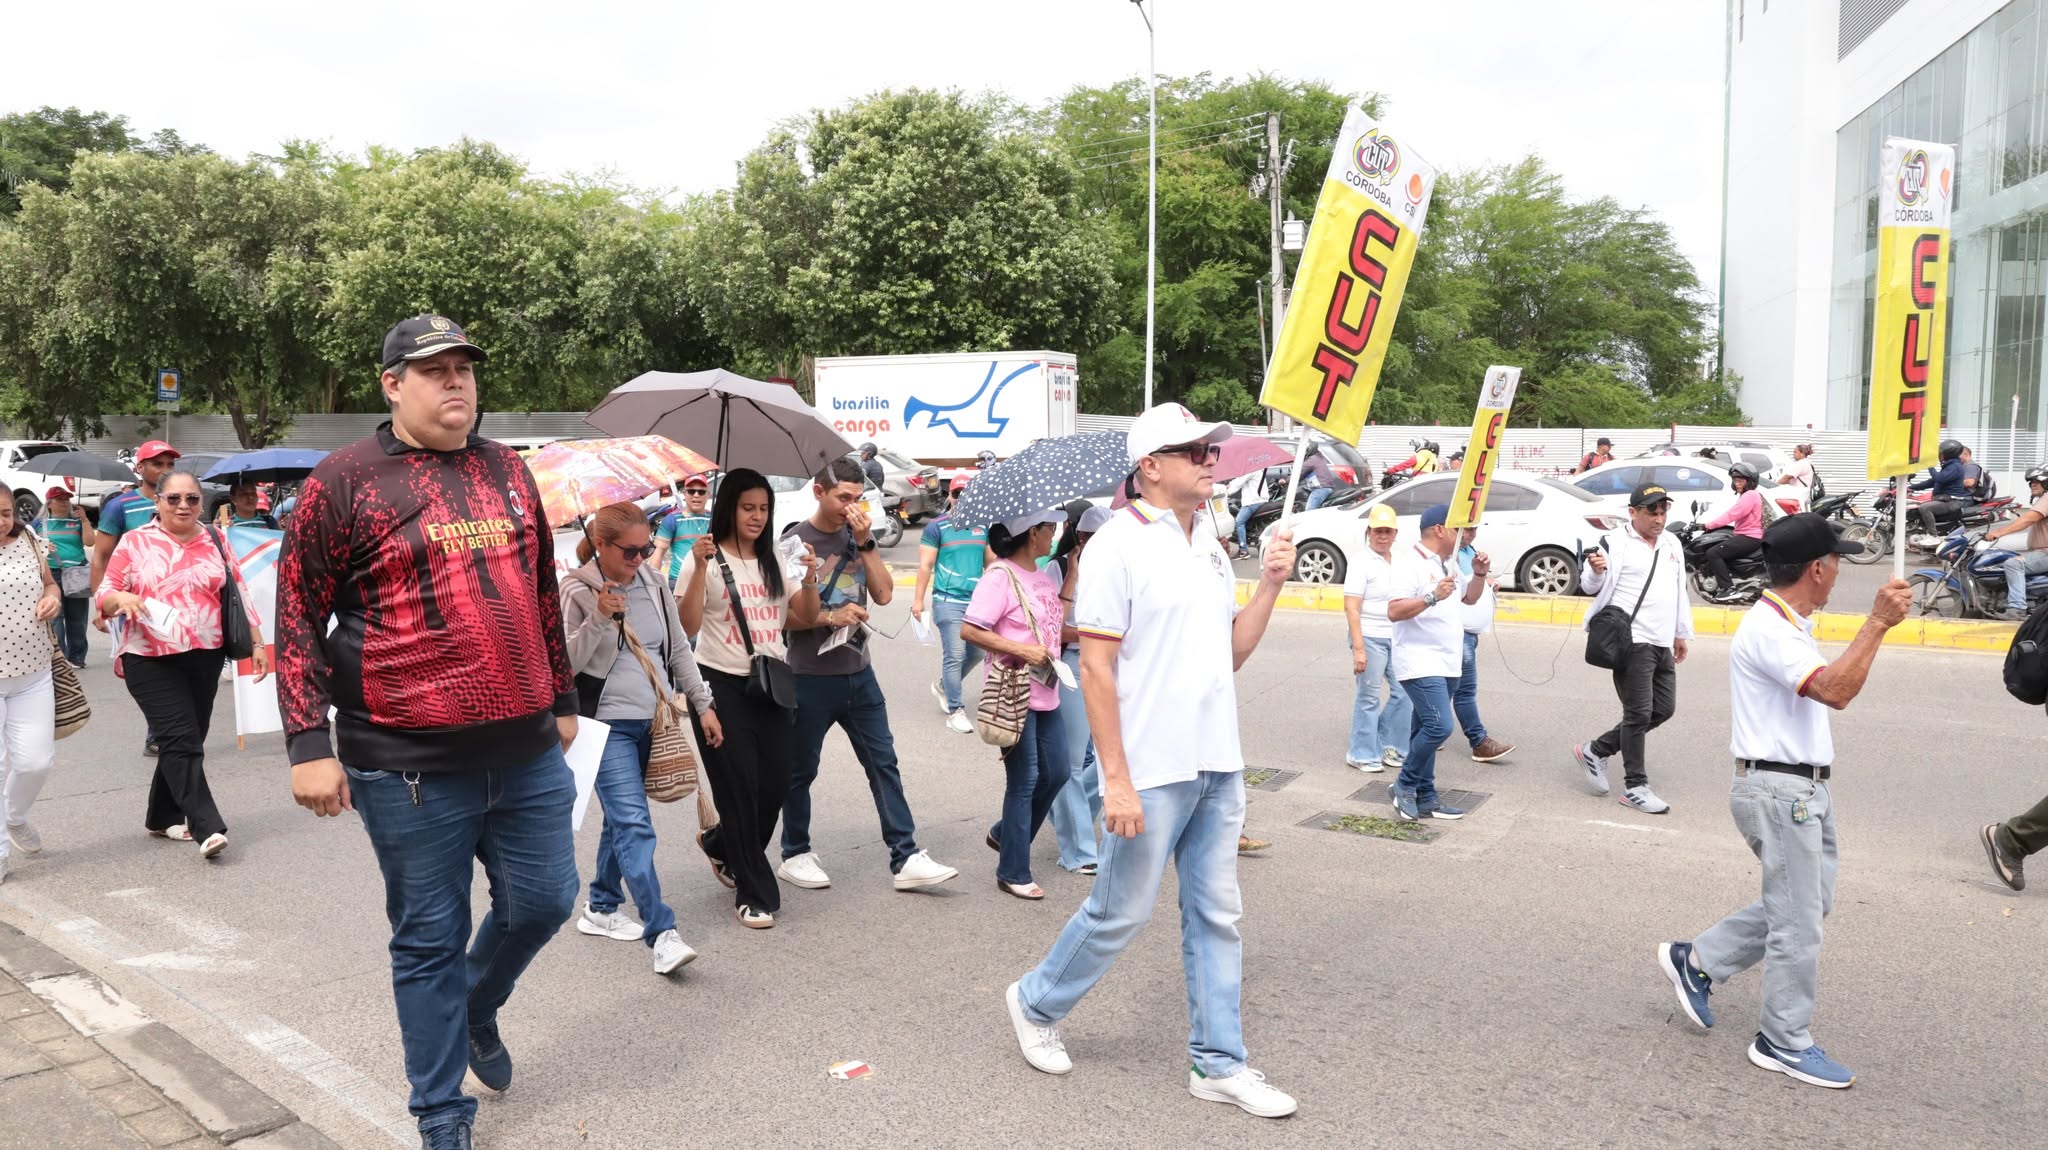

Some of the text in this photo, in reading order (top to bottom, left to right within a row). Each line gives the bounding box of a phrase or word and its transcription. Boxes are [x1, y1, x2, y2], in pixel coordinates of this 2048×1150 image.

[1345, 170, 1392, 208] CÓRDOBA
[1895, 206, 1933, 222] CÓRDOBA
[1311, 208, 1400, 422] CUT
[1897, 233, 1940, 464] CUT
[833, 396, 889, 410] brasilia
[833, 419, 890, 437] carga
[426, 518, 514, 541] Emirates
[443, 533, 509, 554] FLY BETTER
